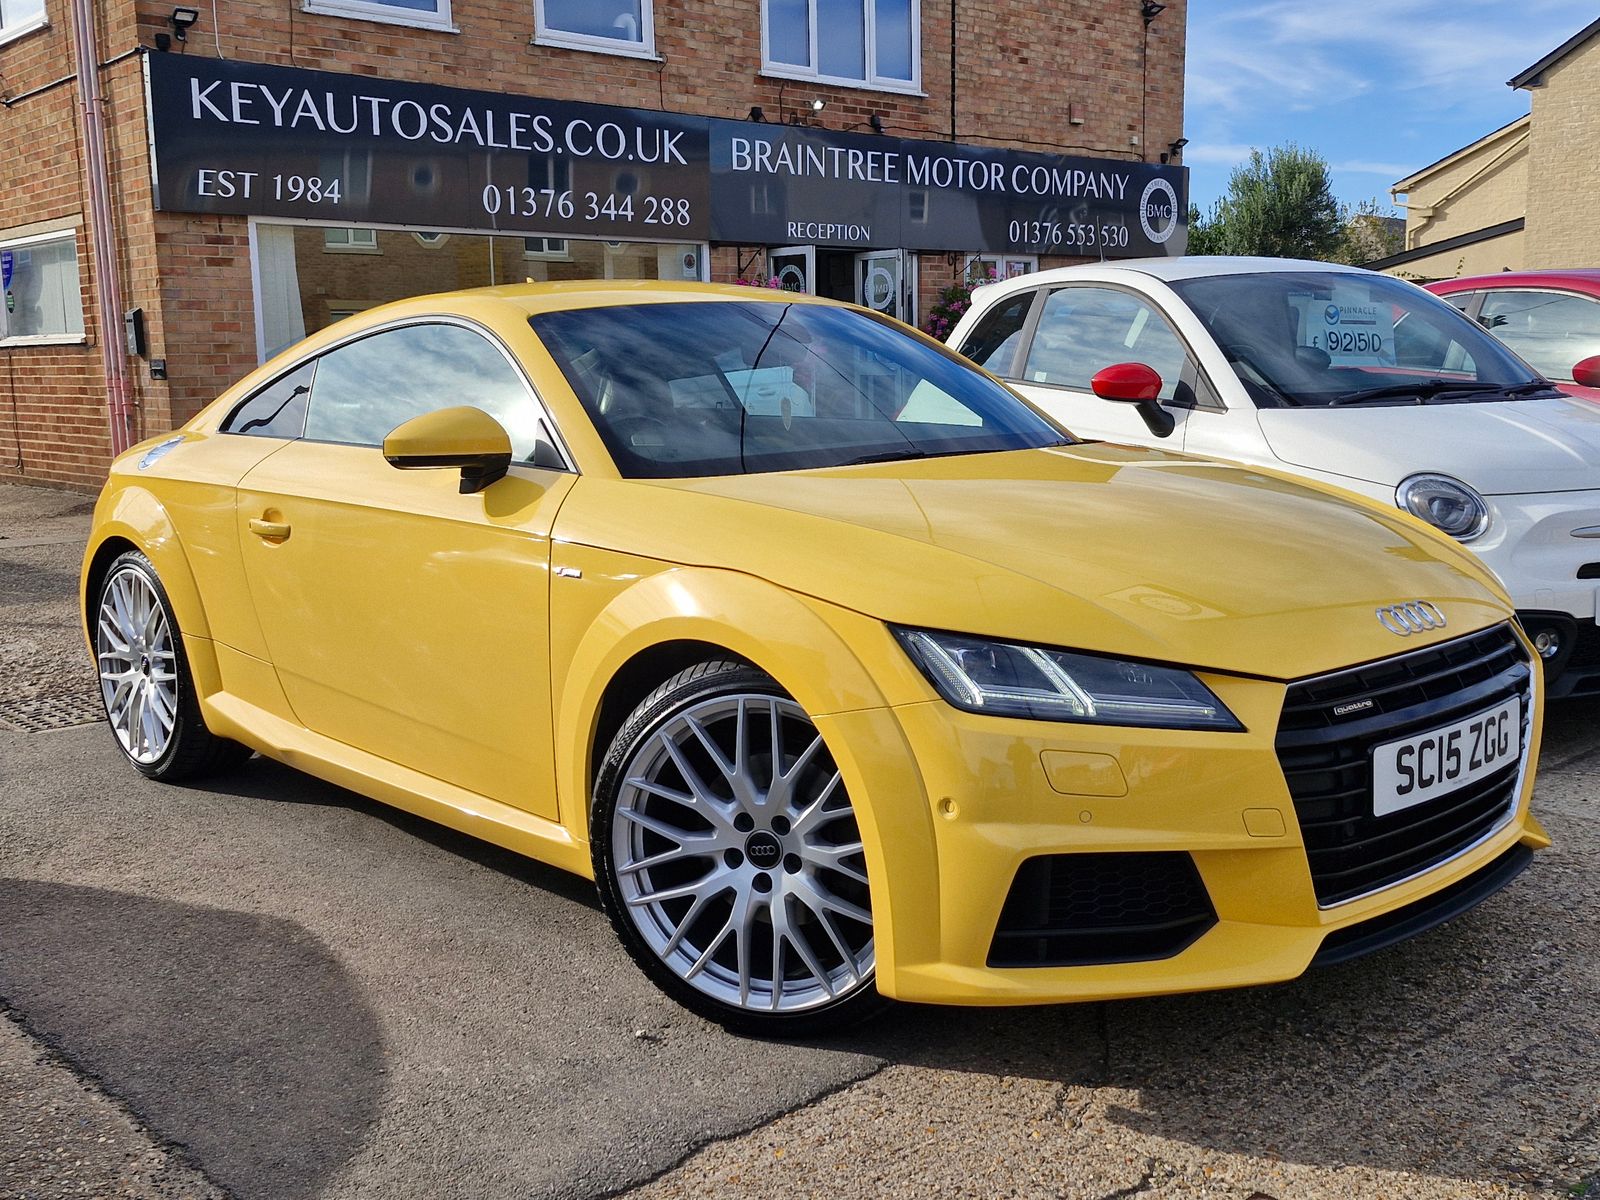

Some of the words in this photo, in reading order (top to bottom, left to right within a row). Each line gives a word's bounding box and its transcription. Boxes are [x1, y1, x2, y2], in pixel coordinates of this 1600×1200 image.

[190, 77, 688, 165] KEYAUTOSALES.CO.UK
[731, 137, 899, 183] BRAINTREE
[907, 154, 1005, 192] MOTOR
[1011, 165, 1130, 200] COMPANY
[198, 169, 258, 198] EST
[273, 174, 342, 204] 1984
[482, 184, 574, 219] 01376
[585, 192, 635, 222] 344
[644, 196, 690, 226] 288
[1147, 204, 1171, 218] BMC
[787, 221, 870, 241] RECEPTION
[1009, 220, 1062, 245] 01376
[1066, 223, 1096, 246] 553
[1100, 226, 1129, 247] 530
[1340, 306, 1377, 315] PINNACLE
[1337, 700, 1372, 714] quattro
[1396, 729, 1462, 795] SC15
[1469, 710, 1509, 772] ZGG
